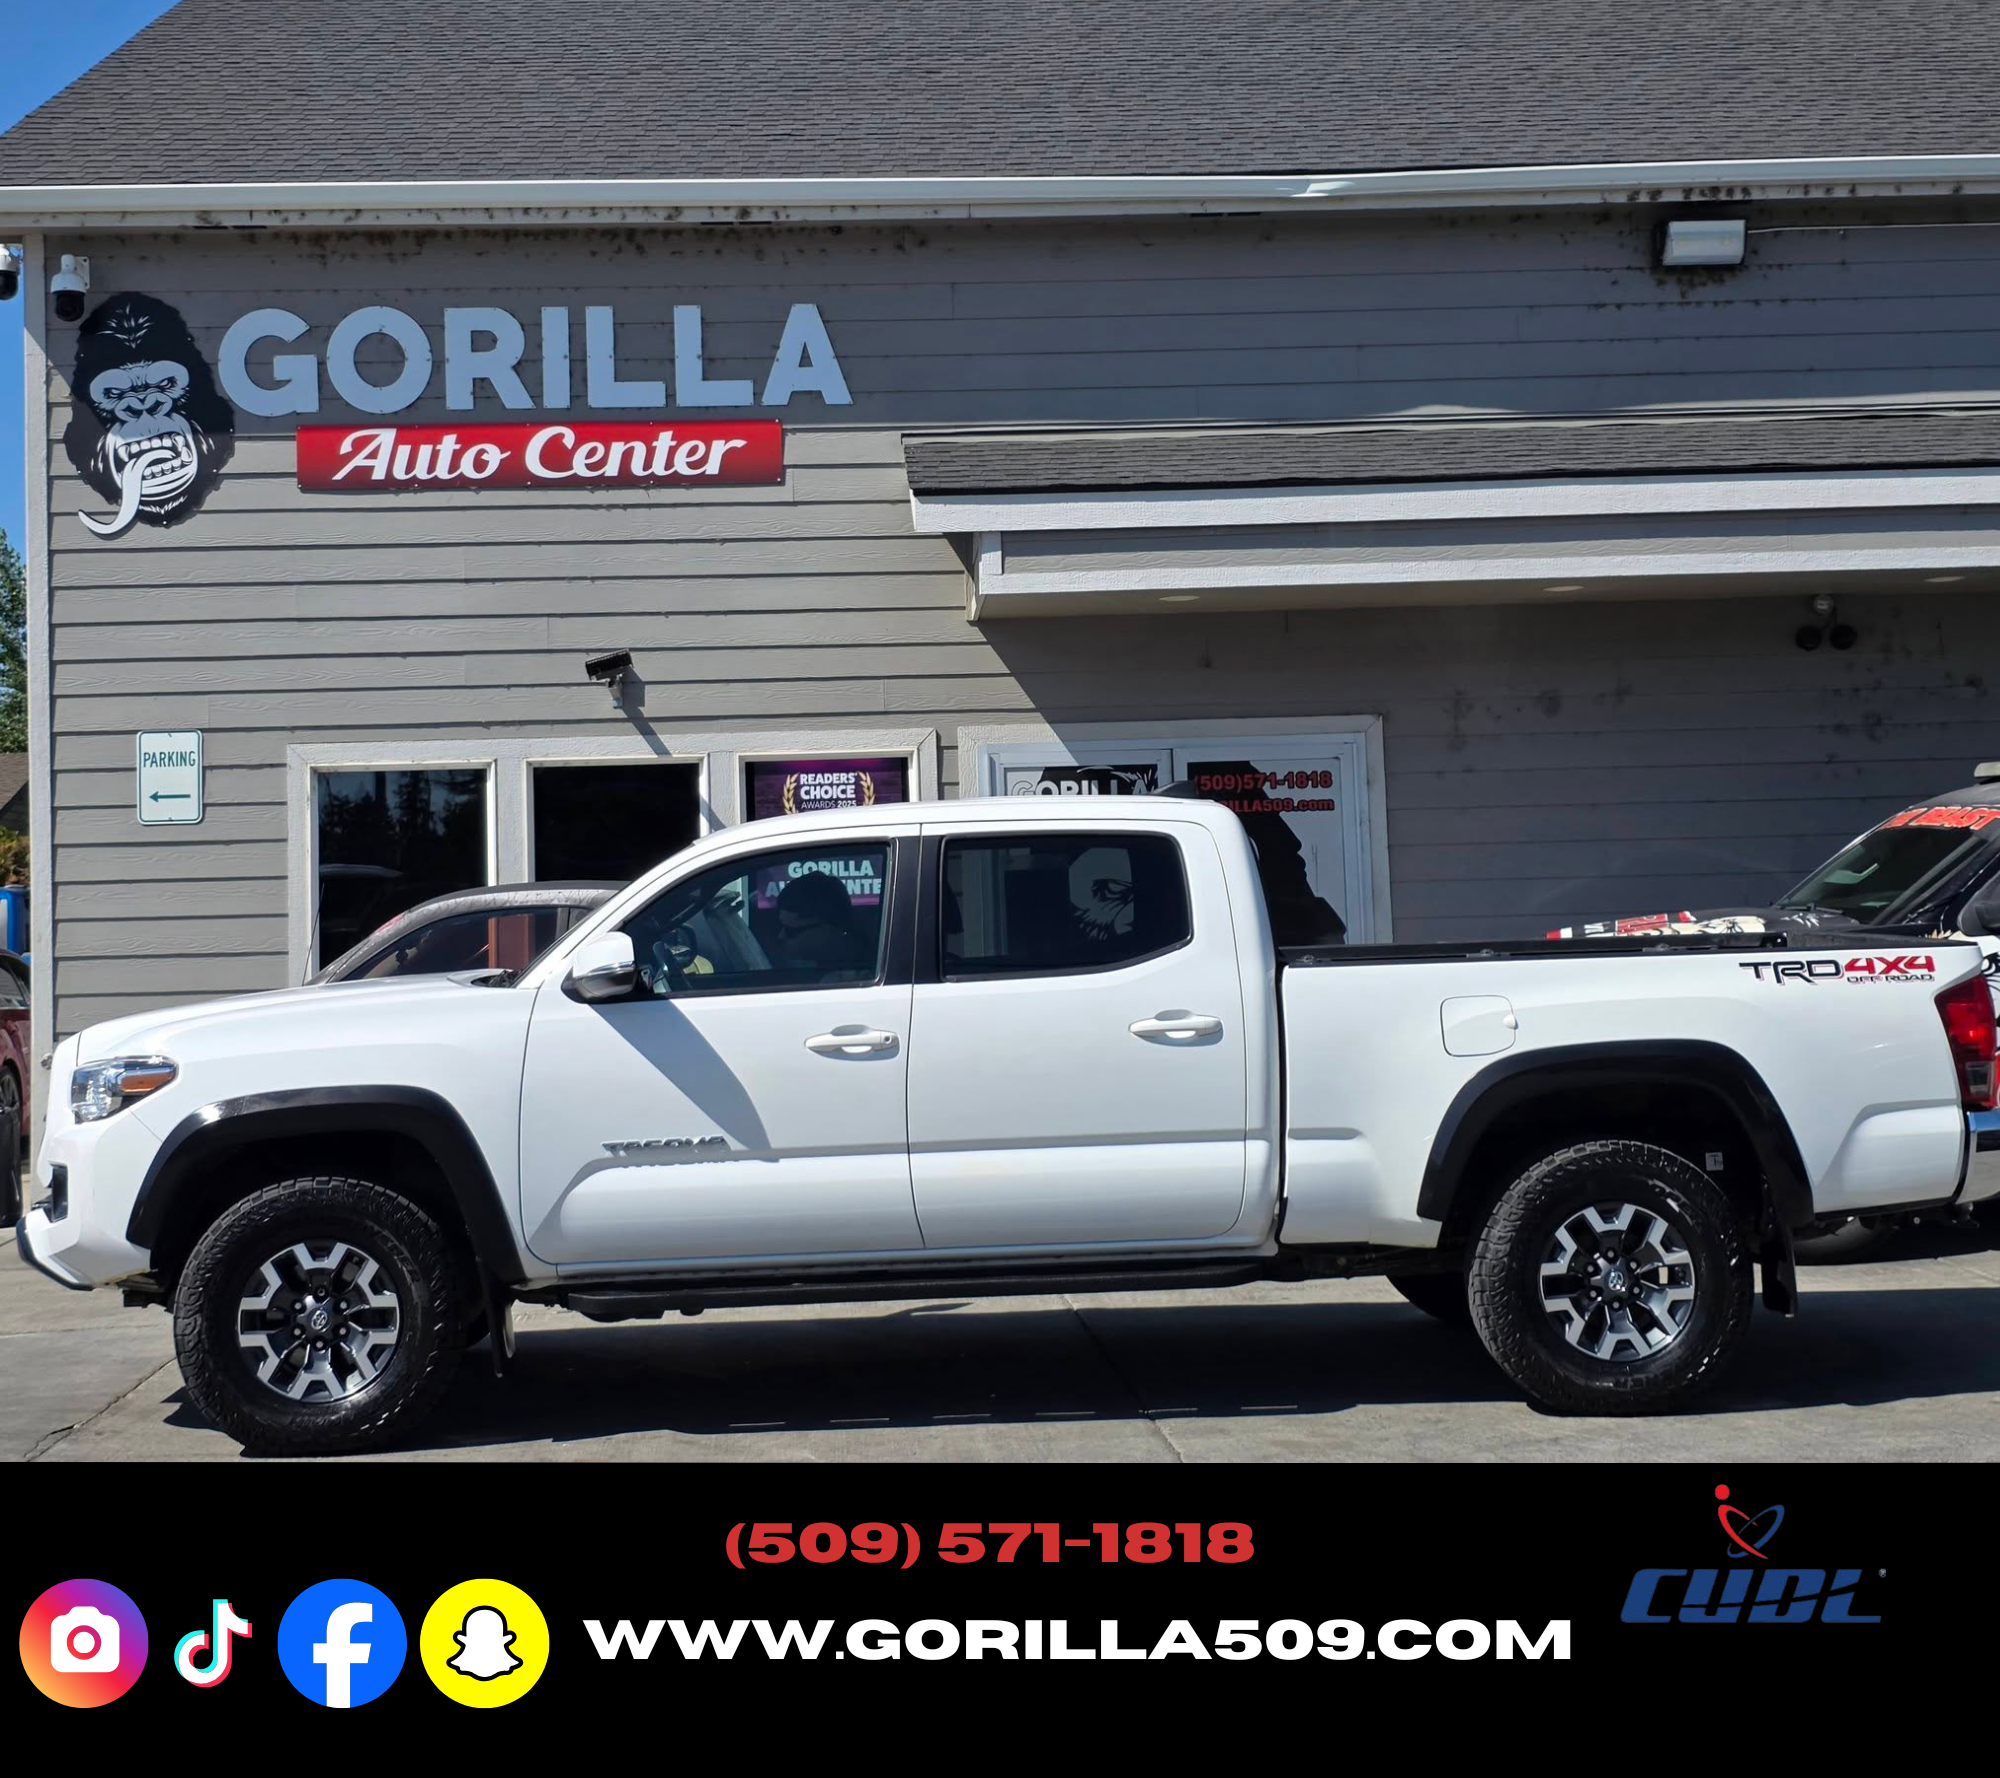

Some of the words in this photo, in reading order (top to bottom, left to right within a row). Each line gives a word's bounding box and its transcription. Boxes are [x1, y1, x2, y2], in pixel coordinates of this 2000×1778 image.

[218, 303, 854, 418] GORILLA
[332, 427, 511, 481] Auto
[524, 425, 748, 479] Center
[143, 750, 196, 768] PARKING
[800, 773, 857, 785] READERS'
[1194, 771, 1334, 795] (509)571-1818
[800, 785, 856, 800] CHOICE
[801, 800, 836, 809] AWARDS
[837, 800, 857, 808] 2025
[787, 859, 874, 879] GORILLA
[1739, 959, 1844, 985] TRD
[1847, 974, 1882, 984] OFF
[1885, 973, 1936, 983] ROAD
